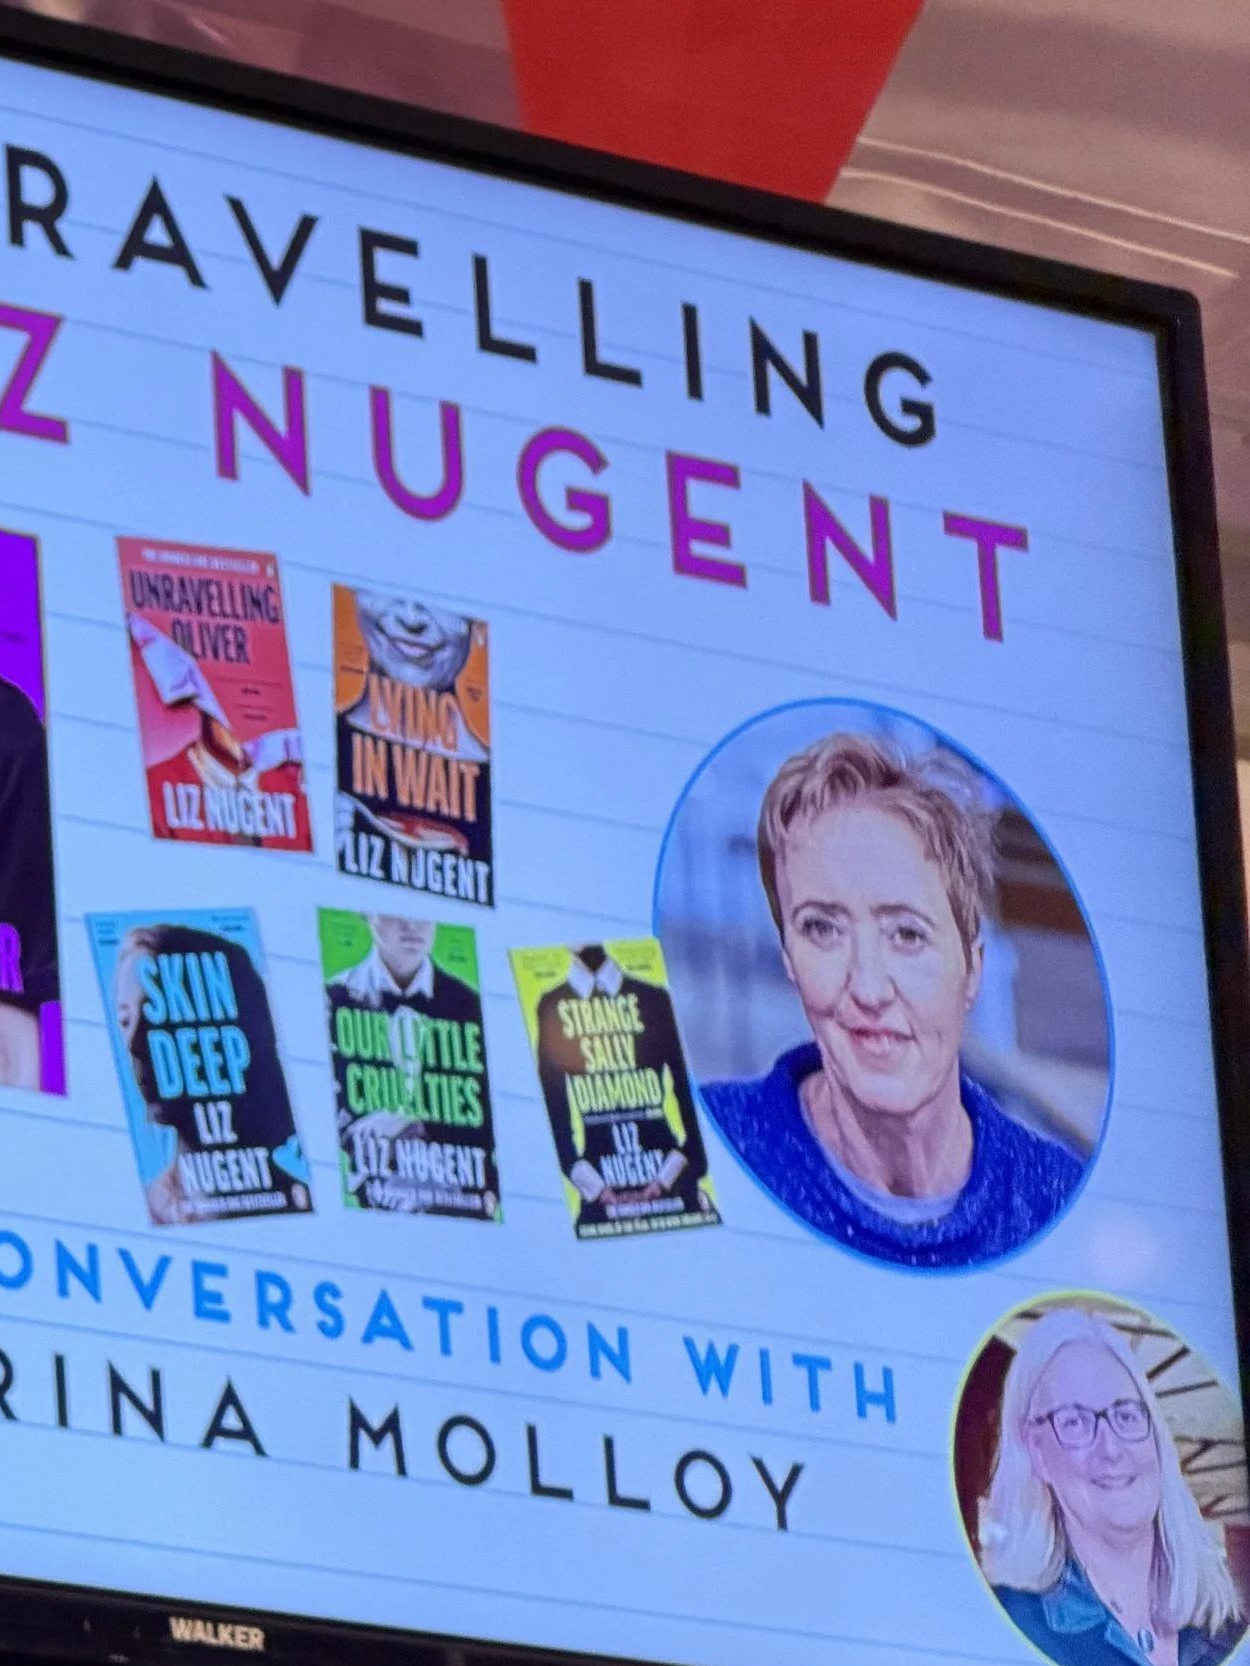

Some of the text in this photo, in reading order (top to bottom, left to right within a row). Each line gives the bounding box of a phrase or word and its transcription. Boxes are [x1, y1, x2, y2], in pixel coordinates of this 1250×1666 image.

[209, 349, 1030, 644] NUGENT
[129, 570, 280, 625] UNRAVELLING
[171, 617, 251, 665] OLIVER
[368, 672, 459, 751] LYING
[162, 780, 298, 840] LIZ NUGENT
[351, 732, 481, 824] IN WAIT
[339, 829, 490, 904] LIZ NUGENT
[136, 949, 240, 1027] SKIN
[557, 993, 645, 1040] STRANGE
[147, 1024, 251, 1099] DEEP
[335, 1006, 485, 1073] OUR LITTLE
[579, 1033, 636, 1074] SALLY
[191, 1099, 239, 1145] LIZ
[345, 1062, 485, 1128] CRUELTIES
[570, 1066, 663, 1114] DIAMOND
[347, 1128, 487, 1192] LIZ NUGENT
[611, 1121, 643, 1154] LIZ
[177, 1146, 273, 1197] NUGENT
[682, 1335, 897, 1425] WITH
[348, 1395, 805, 1531] MOLLOY
[169, 1616, 265, 1652] WALKER
